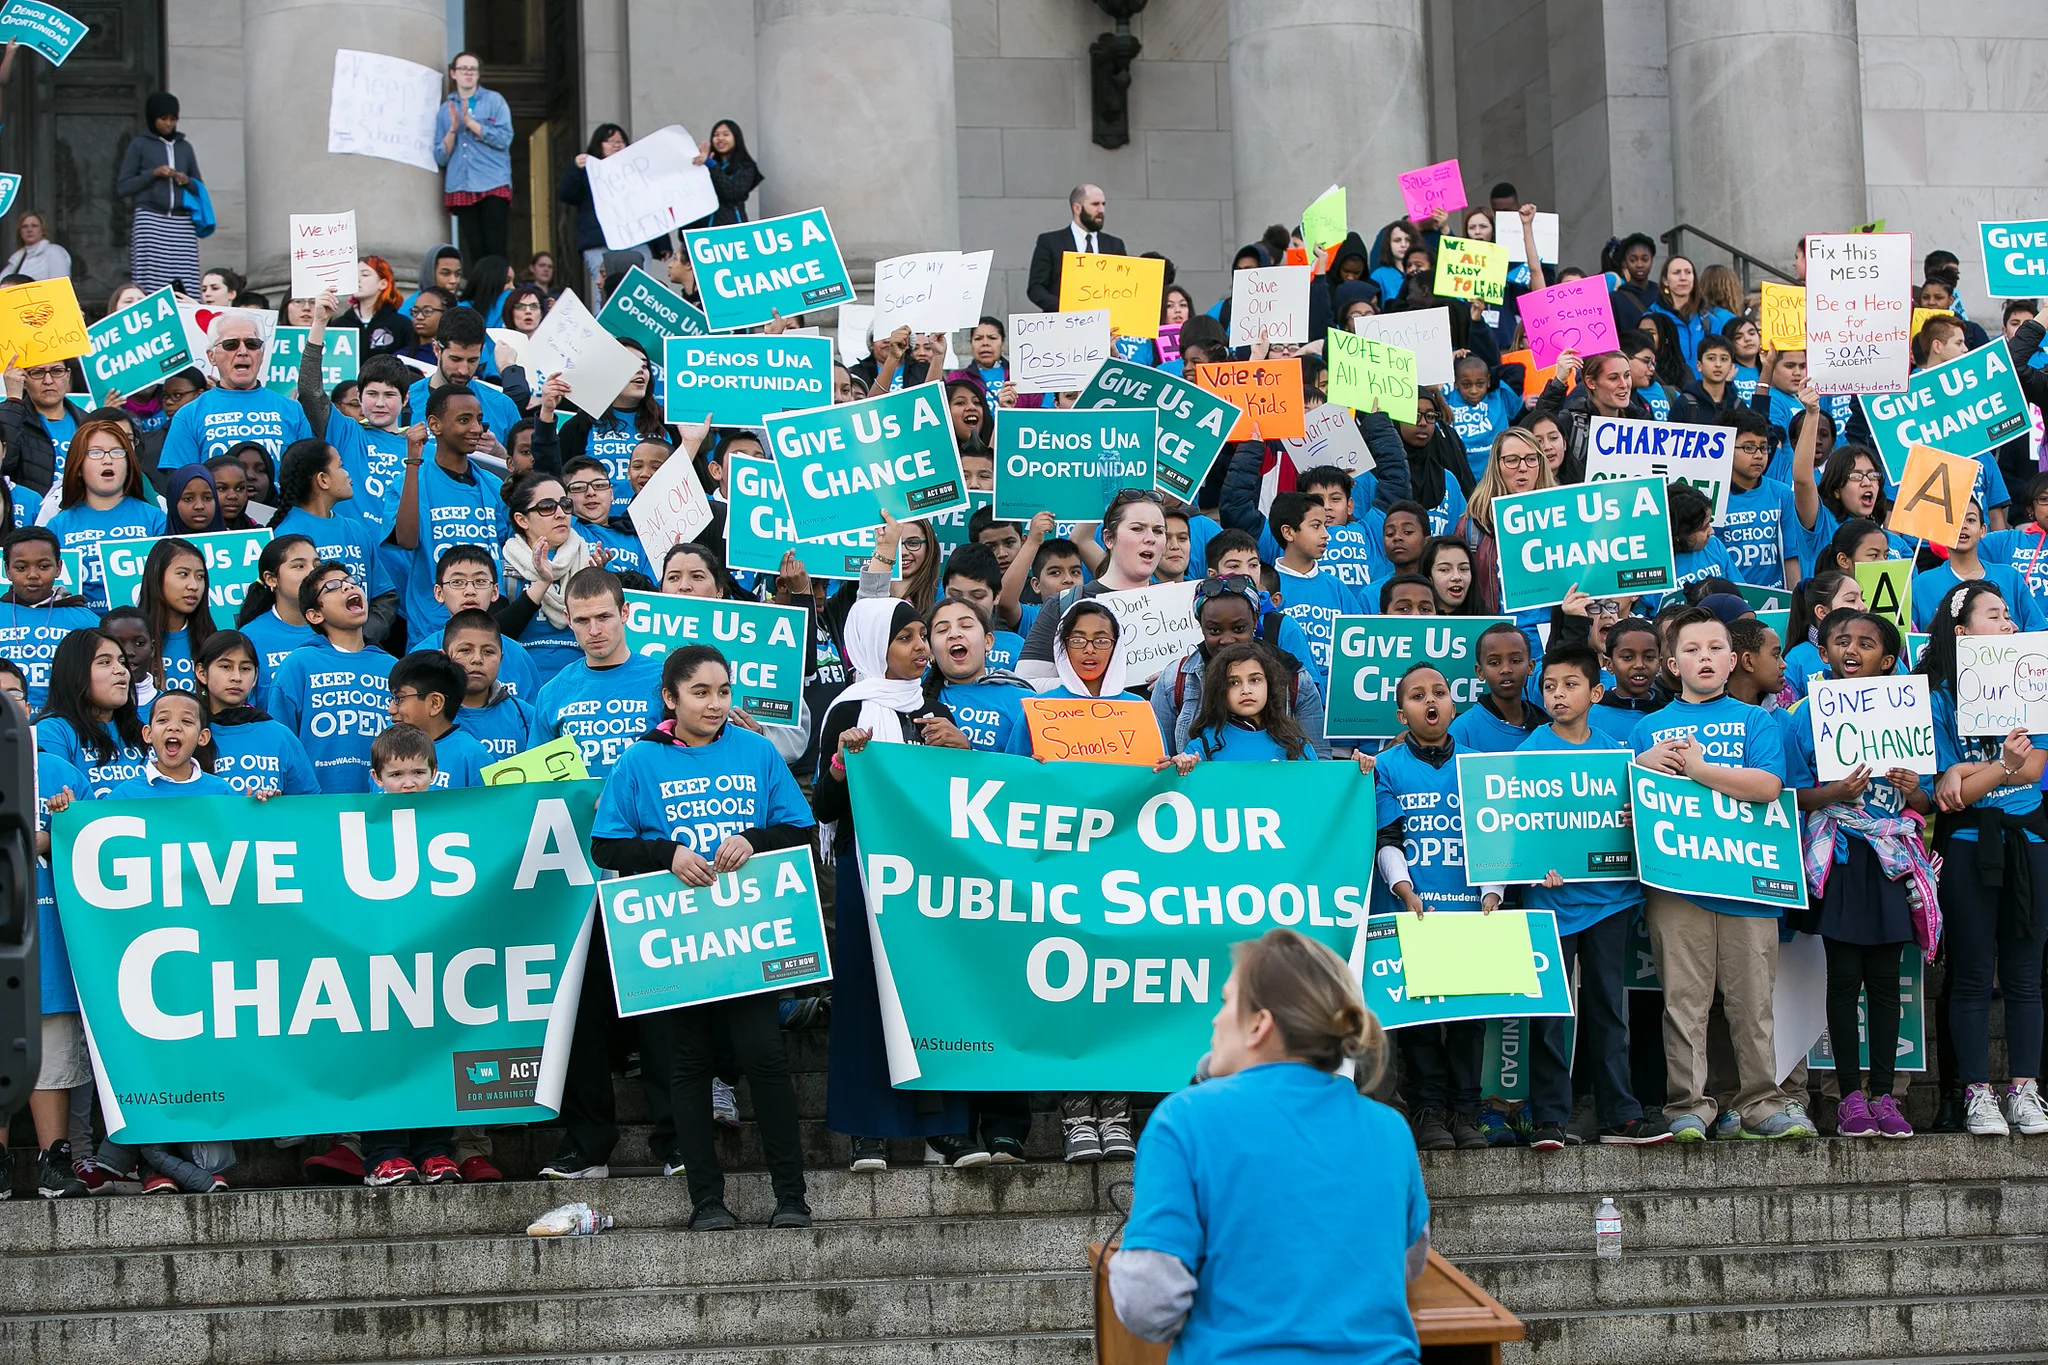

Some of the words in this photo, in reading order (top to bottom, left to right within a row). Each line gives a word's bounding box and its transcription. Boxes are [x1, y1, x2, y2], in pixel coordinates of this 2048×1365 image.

[1, 15, 69, 47] OPORTUNIDAD
[11, 4, 45, 20] DÉNOS
[47, 14, 71, 35] UNA
[693, 237, 750, 264] GIVE
[752, 228, 793, 255] US
[802, 219, 826, 246] A
[1443, 239, 1465, 251] WE
[1809, 239, 1835, 260] Fix
[1842, 243, 1877, 260] this
[1988, 228, 2047, 249] GIVE
[1076, 256, 1086, 268] I
[1447, 264, 1482, 276] READY
[1460, 254, 1487, 268] ARE
[1830, 266, 1879, 280] MESS
[714, 259, 824, 298] CHANCE
[1248, 270, 1278, 295] Save
[1454, 277, 1472, 292] TO
[632, 283, 680, 323] DÉNOS
[1078, 283, 1138, 302] School
[1546, 283, 1583, 304] Save
[1816, 294, 1839, 311] Be
[1845, 299, 1856, 310] a
[1865, 294, 1902, 311] Hero
[123, 310, 153, 334] US
[157, 297, 175, 322] A
[1017, 315, 1055, 335] Don't
[1845, 315, 1867, 328] for
[34, 320, 86, 353] School
[1239, 314, 1293, 343] School
[1809, 332, 1832, 343] WA
[1838, 327, 1907, 343] Students
[95, 331, 176, 381] CHANCE
[333, 335, 352, 355] A
[1825, 345, 1880, 360] SOAR
[687, 349, 758, 367] DÉNOS
[767, 349, 813, 369] UNA
[1019, 343, 1103, 373] Possible
[1829, 357, 1872, 367] ACADEMY
[677, 370, 822, 392] OPORTUNIDAD
[1201, 366, 1248, 389] Vote
[1253, 365, 1282, 386] for
[1871, 386, 1932, 421] GIVE
[1937, 367, 1979, 396] US
[1986, 350, 2008, 380] A
[1098, 367, 1152, 401] GIVE
[1156, 383, 1194, 421] US
[1196, 407, 1223, 438] A
[1247, 393, 1287, 416] Kids
[204, 413, 243, 426] KEEP
[247, 412, 281, 422] OUR
[776, 425, 846, 459] GIVE
[852, 412, 901, 444] US
[912, 396, 941, 432] A
[1895, 392, 2008, 449] CHANCE
[206, 424, 282, 441] SCHOOLS
[1018, 427, 1092, 450] DÉNOS
[1100, 427, 1140, 449] UNA
[1595, 422, 1727, 459] CHARTERS
[802, 449, 936, 500] CHANCE
[1007, 455, 1147, 478] OPORTUNIDAD
[927, 488, 939, 498] ACT
[939, 484, 953, 495] NOW
[1903, 462, 1954, 525] A
[430, 507, 471, 521] KEEP
[1503, 504, 1567, 535] GIVE
[1577, 491, 1621, 522] US
[1631, 486, 1660, 517] A
[65, 529, 106, 545] KEEP
[110, 526, 146, 540] OUR
[1521, 535, 1648, 573] CHANCE
[1636, 571, 1647, 579] ACT
[1648, 569, 1663, 578] NOW
[1109, 595, 1151, 618] Don't
[1869, 572, 1905, 627] A
[626, 601, 699, 639] GIVE
[713, 610, 756, 643] US
[768, 617, 796, 648] A
[1142, 610, 1193, 635] Steal
[1126, 640, 1183, 665] ossible!
[1340, 625, 1413, 659] GIVE
[1425, 627, 1468, 659] US
[1958, 637, 2018, 667] Save
[309, 672, 356, 689] KEEP
[1958, 668, 2010, 702] Our
[557, 702, 604, 719] KEEP
[607, 700, 648, 715] OUR
[762, 701, 773, 709] ACT
[1032, 700, 1087, 721] Save
[1092, 701, 1128, 719] Our
[1818, 686, 1878, 717] GIVE
[1887, 685, 1916, 708] US
[562, 717, 647, 736] SCHOOLS
[960, 707, 1000, 726] OUR
[1702, 722, 1745, 736] OUR
[1041, 726, 1136, 760] Schools!
[1820, 721, 1833, 743] A
[1835, 722, 1934, 766] CHANCE
[241, 755, 279, 772] OUR
[659, 778, 713, 799] KEEP
[715, 774, 757, 792] OUR
[1485, 773, 1563, 800] DÉNOS
[1570, 772, 1617, 797] UNA
[665, 797, 755, 822] SCHOOLS
[1397, 792, 1441, 810] KEEP
[1637, 777, 1702, 818] GIVE
[1712, 790, 1754, 823] US
[1764, 800, 1791, 828] A
[949, 776, 1115, 853] KEEP
[1137, 790, 1286, 854] OUR
[1476, 807, 1626, 833] OPORTUNIDAD
[71, 815, 304, 910] GIVE
[338, 808, 477, 900] US
[513, 798, 594, 891] A
[1653, 820, 1780, 870] CHANCE
[612, 887, 698, 925] GIVE
[711, 871, 761, 908] US
[774, 861, 806, 897] A
[867, 853, 1082, 924] PUBLIC
[1101, 869, 1363, 928] SCHOOLS
[1769, 881, 1779, 889] ACT
[1780, 882, 1795, 892] NOW
[638, 916, 796, 969] CHANCE
[785, 958, 797, 969] ACT
[798, 955, 814, 967] NOW
[1026, 936, 1210, 1004] OPEN
[117, 926, 557, 1041] CHANCE
[481, 1067, 494, 1077] WA
[510, 1057, 540, 1079] ACT
[467, 1091, 483, 1102] FOR
